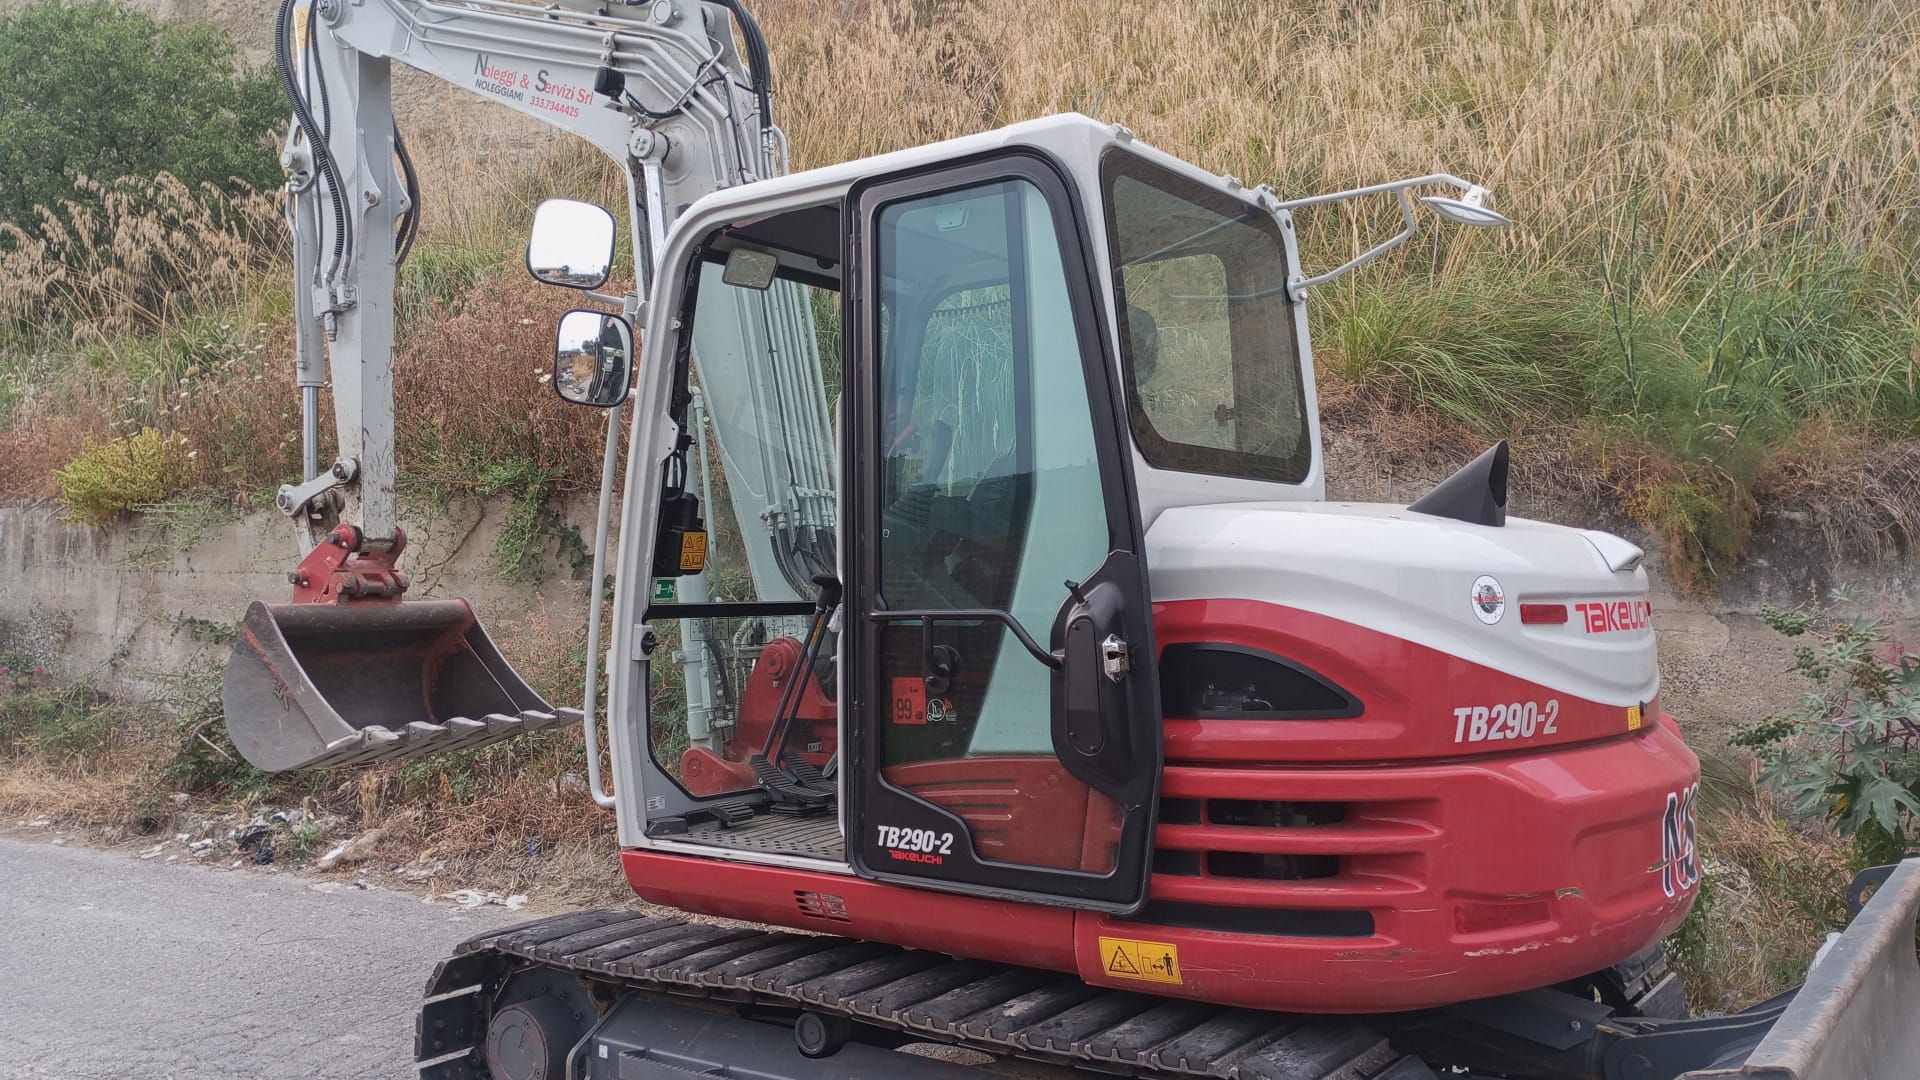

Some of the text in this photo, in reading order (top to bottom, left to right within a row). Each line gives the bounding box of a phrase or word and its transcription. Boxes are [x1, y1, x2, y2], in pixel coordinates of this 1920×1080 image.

[474, 53, 594, 105] Noleggi & Servizi Srl
[475, 78, 580, 118] NOLEGGIAMI 333.7344425
[896, 698, 912, 720] 99
[1453, 699, 1559, 743] TB290-2
[877, 825, 954, 855] TB290-2
[888, 850, 943, 865] TAKEUCHI
